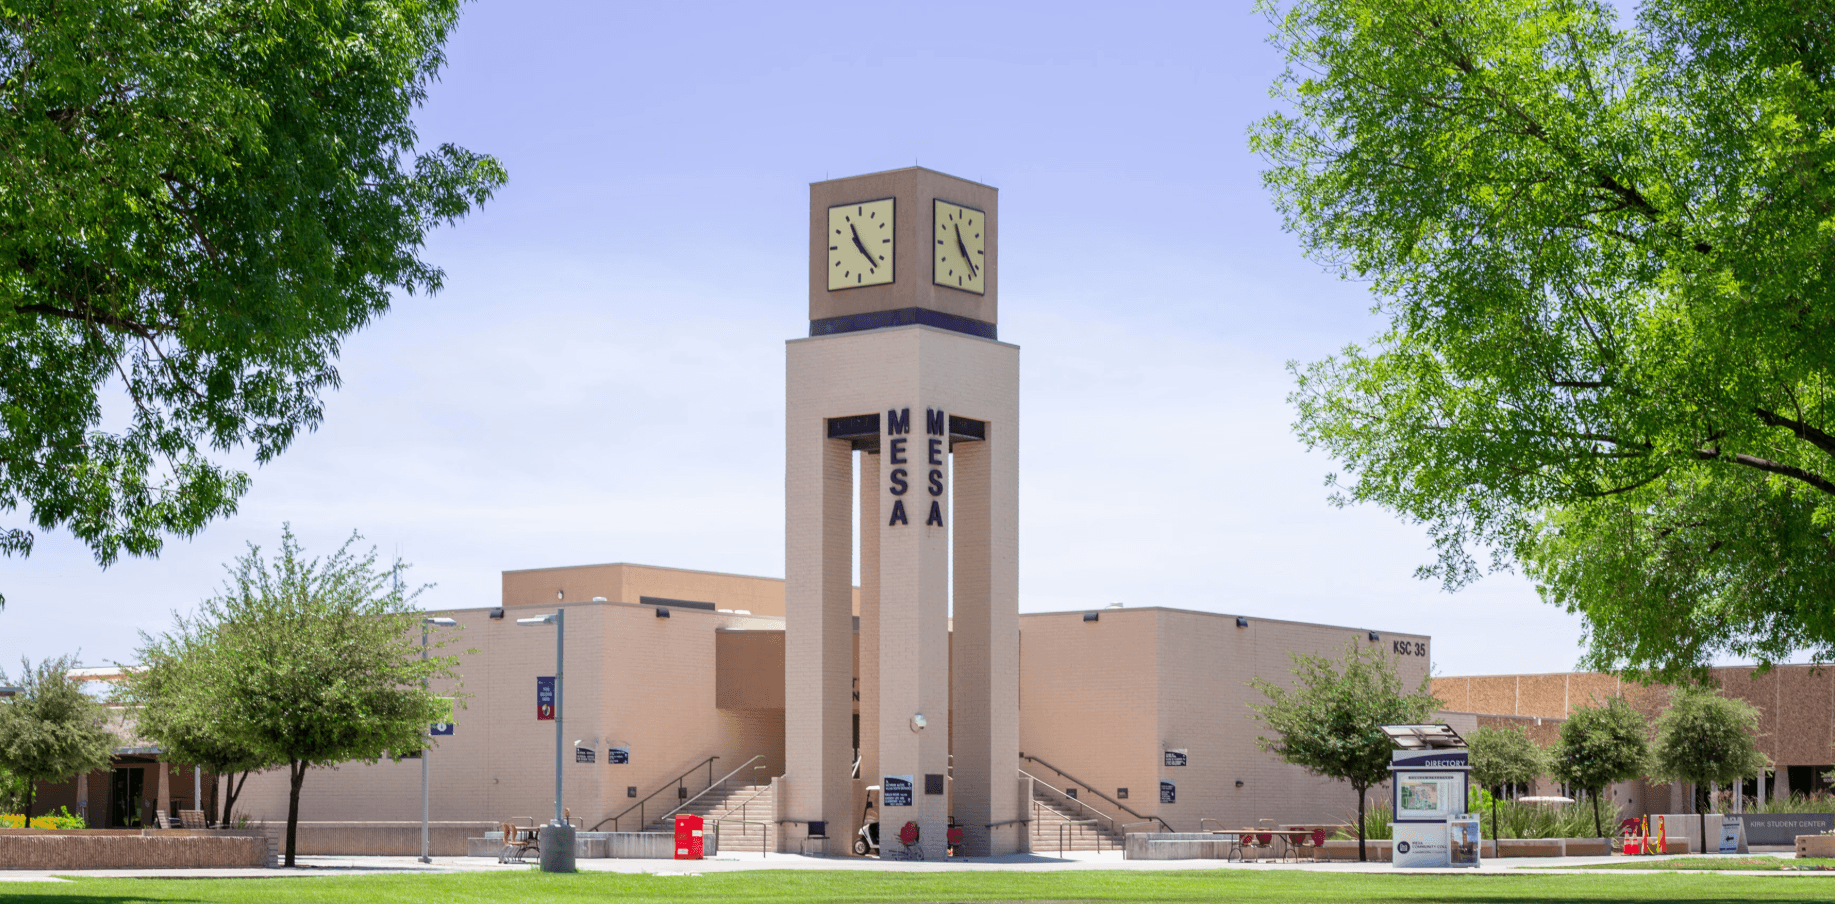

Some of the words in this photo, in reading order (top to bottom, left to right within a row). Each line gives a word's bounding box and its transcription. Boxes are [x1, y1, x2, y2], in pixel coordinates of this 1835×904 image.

[887, 408, 910, 526] MESA
[926, 408, 944, 527] MESA
[1393, 640, 1412, 655] KSC
[1414, 642, 1426, 657] 35
[1767, 820, 1798, 828] STUDENT
[1799, 820, 1826, 828] CENTER
